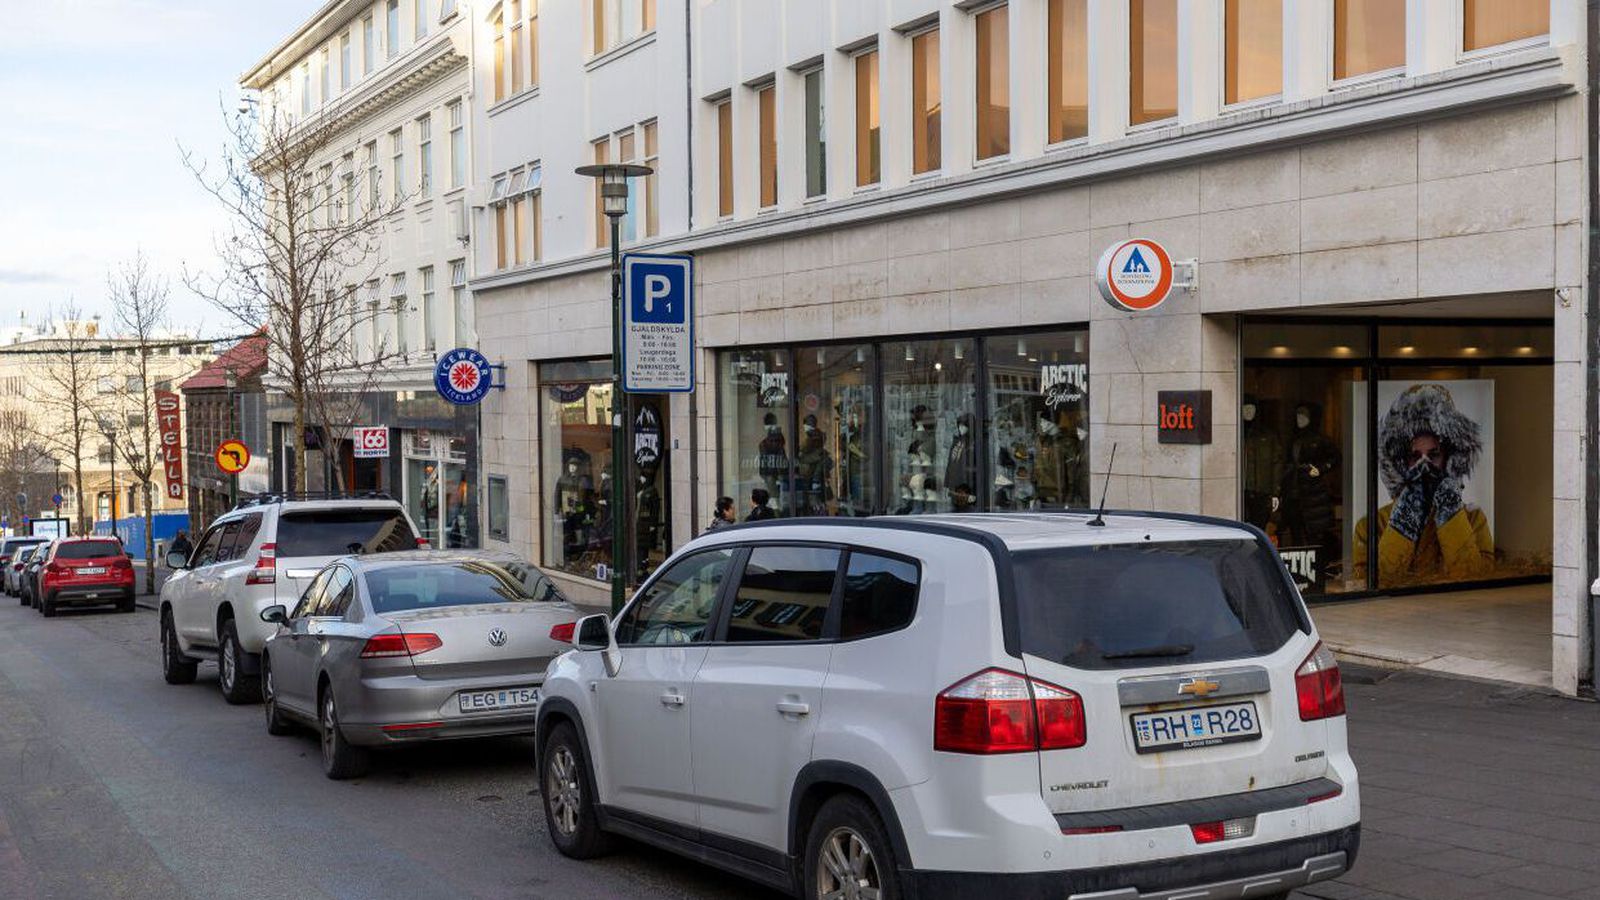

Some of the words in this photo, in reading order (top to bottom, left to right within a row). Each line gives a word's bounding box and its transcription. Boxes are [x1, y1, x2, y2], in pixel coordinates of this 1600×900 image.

[645, 274, 671, 313] P
[666, 302, 672, 313] 1
[440, 351, 488, 376] ICEWEAR
[761, 373, 788, 395] ARCTIC
[1041, 364, 1088, 395] ARCTIC
[447, 388, 483, 401] ICELAND
[1160, 404, 1194, 429] loft
[157, 397, 181, 496] STELLA
[635, 433, 658, 457] ARCTIC
[473, 693, 496, 707] EG
[509, 689, 539, 704] T54
[1151, 714, 1188, 741] RH
[1207, 708, 1253, 734] R28
[1050, 780, 1109, 792] CHEVROLET
